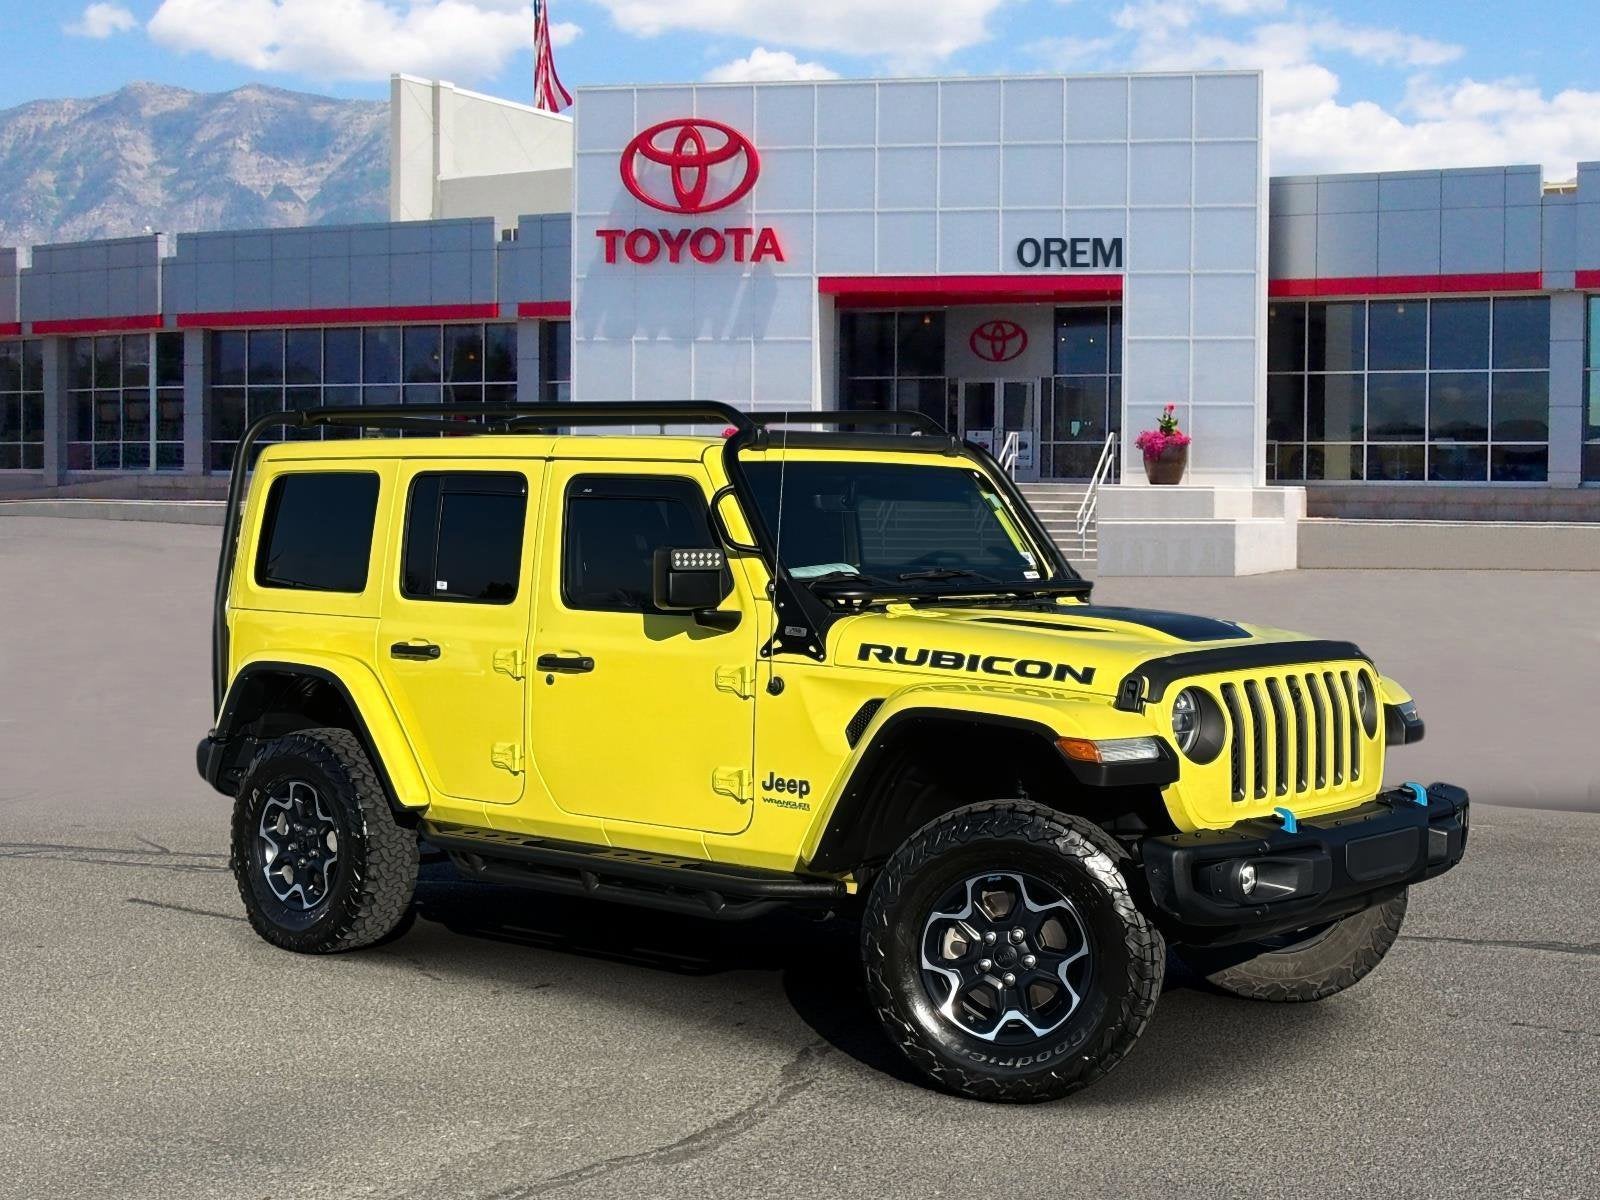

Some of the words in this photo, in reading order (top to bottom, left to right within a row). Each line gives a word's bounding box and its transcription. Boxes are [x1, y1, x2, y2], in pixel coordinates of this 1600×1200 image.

[596, 227, 784, 264] TOYOTA
[1017, 237, 1122, 268] OREM
[857, 642, 1097, 686] RUBICON
[761, 772, 810, 799] Jeep
